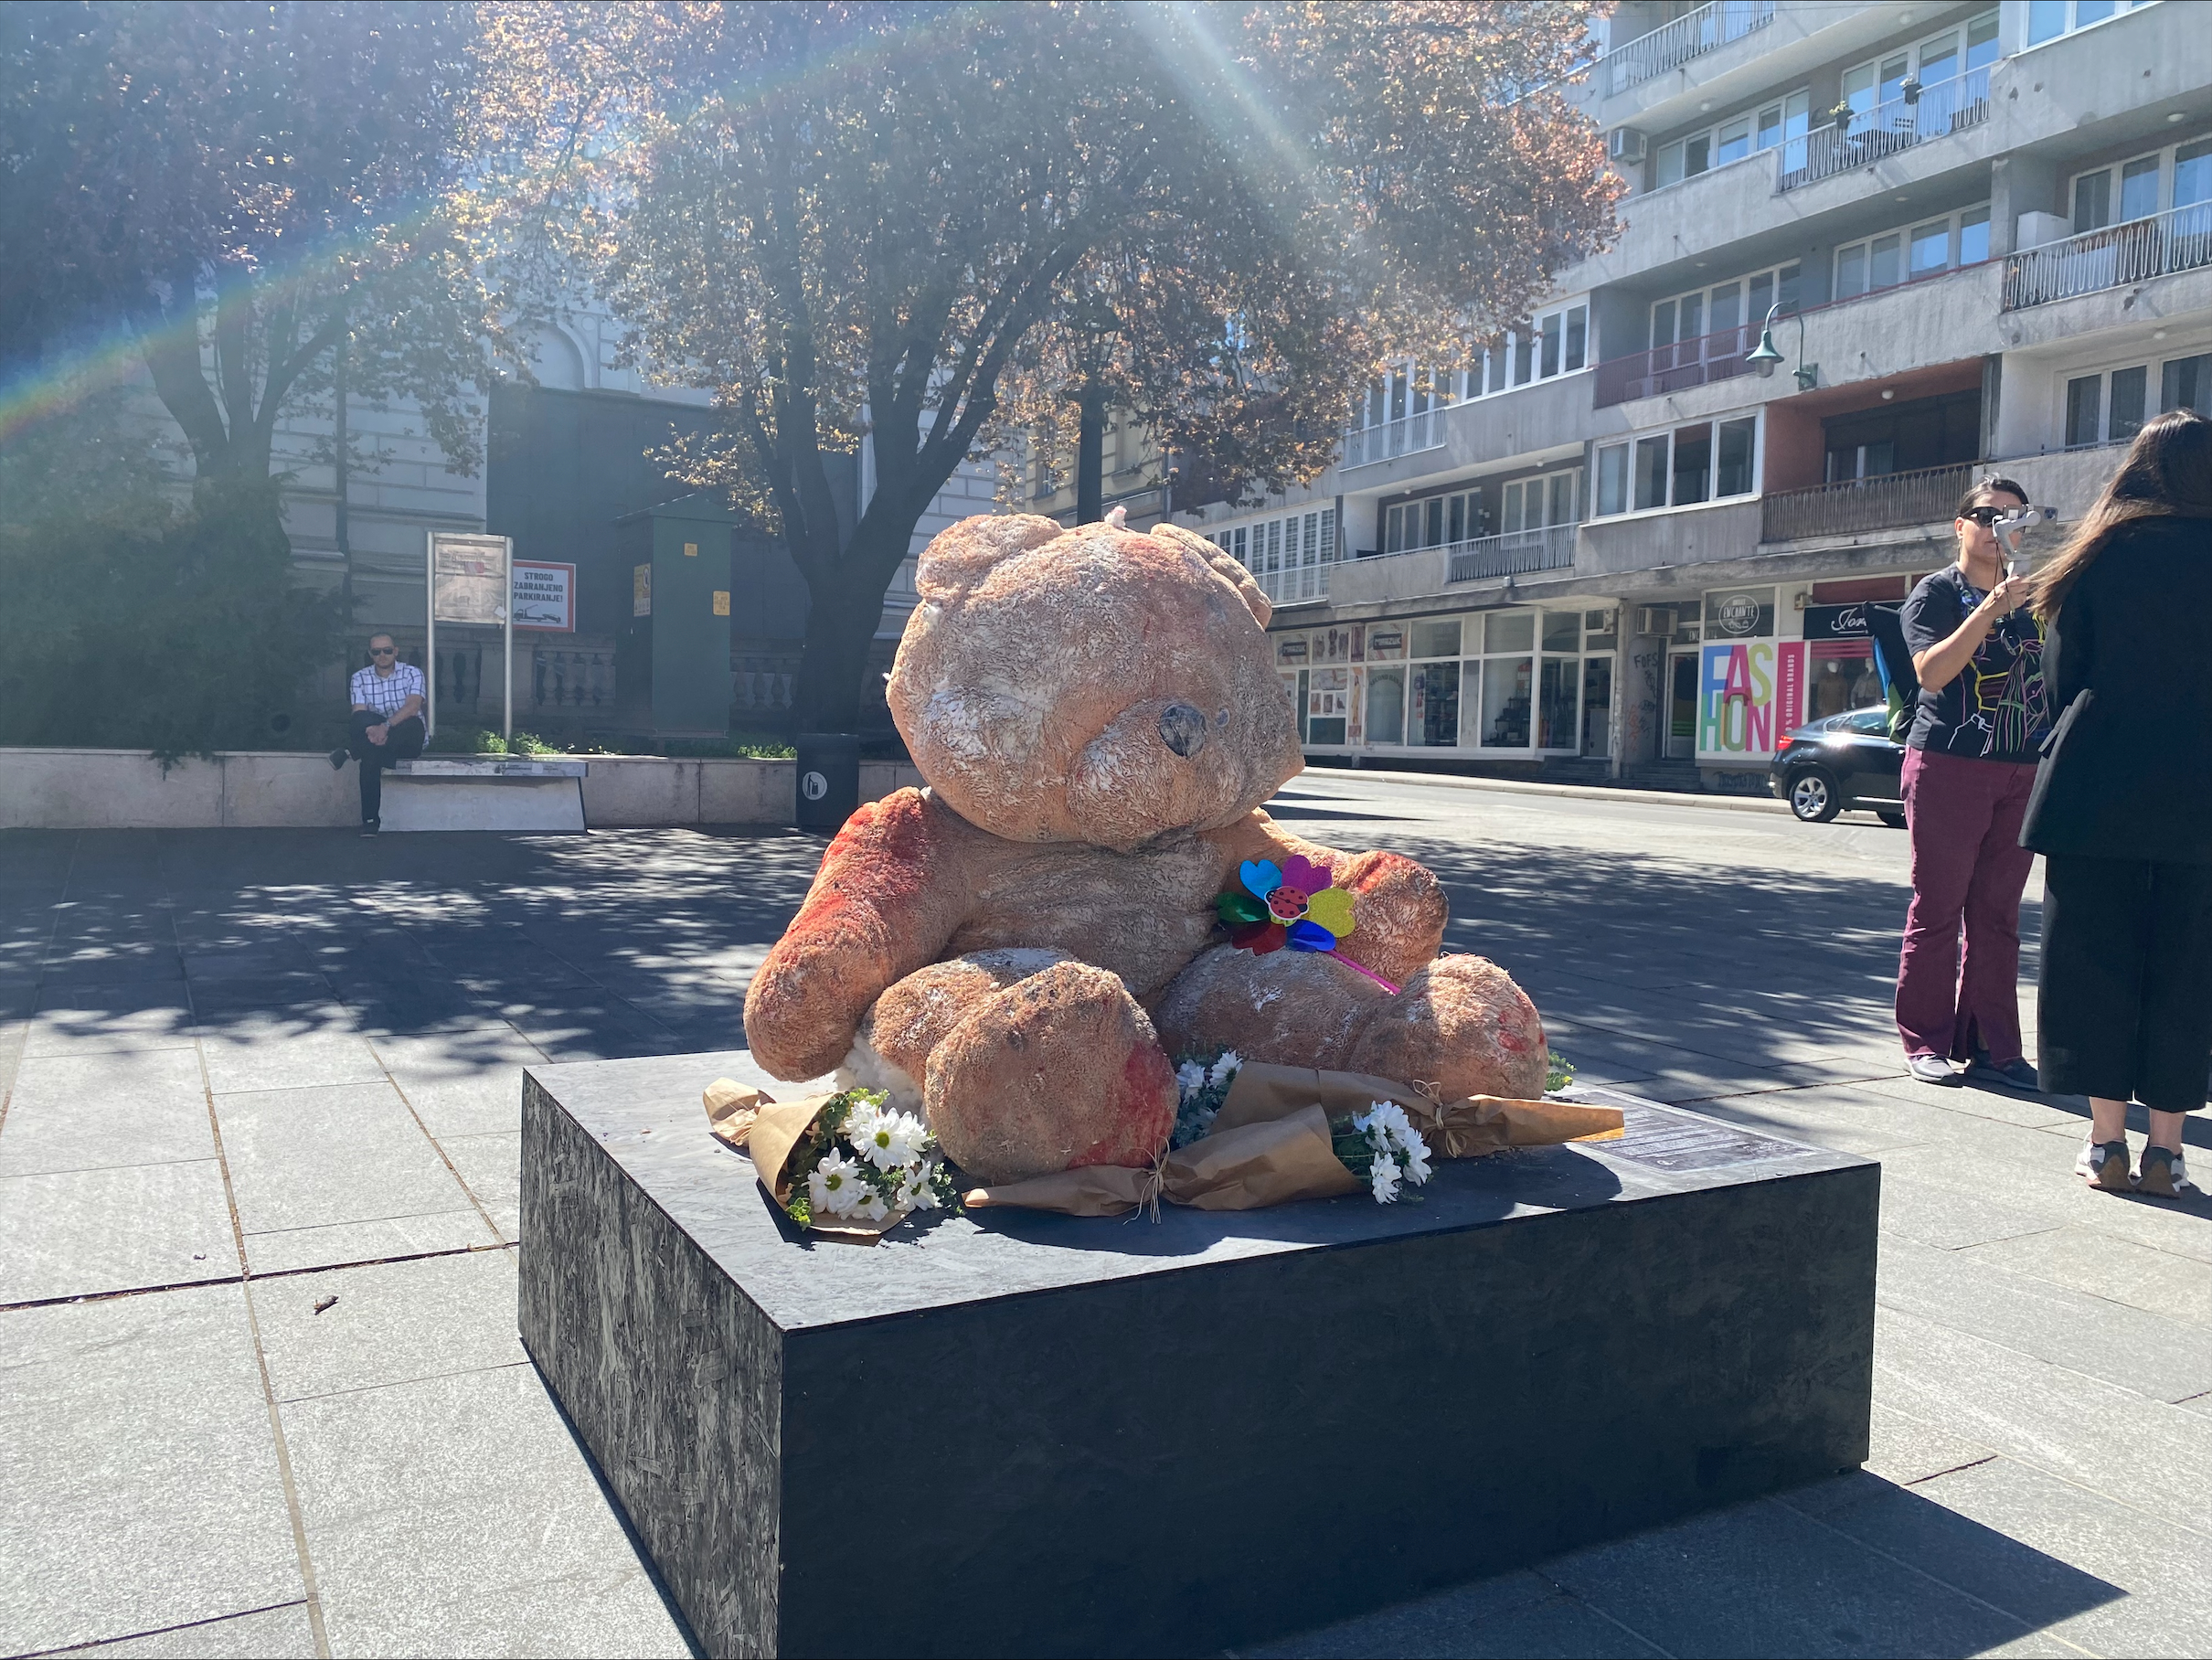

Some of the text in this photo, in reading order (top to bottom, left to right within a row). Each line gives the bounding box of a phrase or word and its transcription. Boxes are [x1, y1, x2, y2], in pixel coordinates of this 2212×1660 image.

[524, 572, 554, 581] STROGO
[514, 581, 563, 592] ZABRANJENO
[514, 591, 563, 602] PARKIRANJE!
[1786, 654, 1795, 682] BRANDS
[1785, 684, 1793, 718] ORIGINAL
